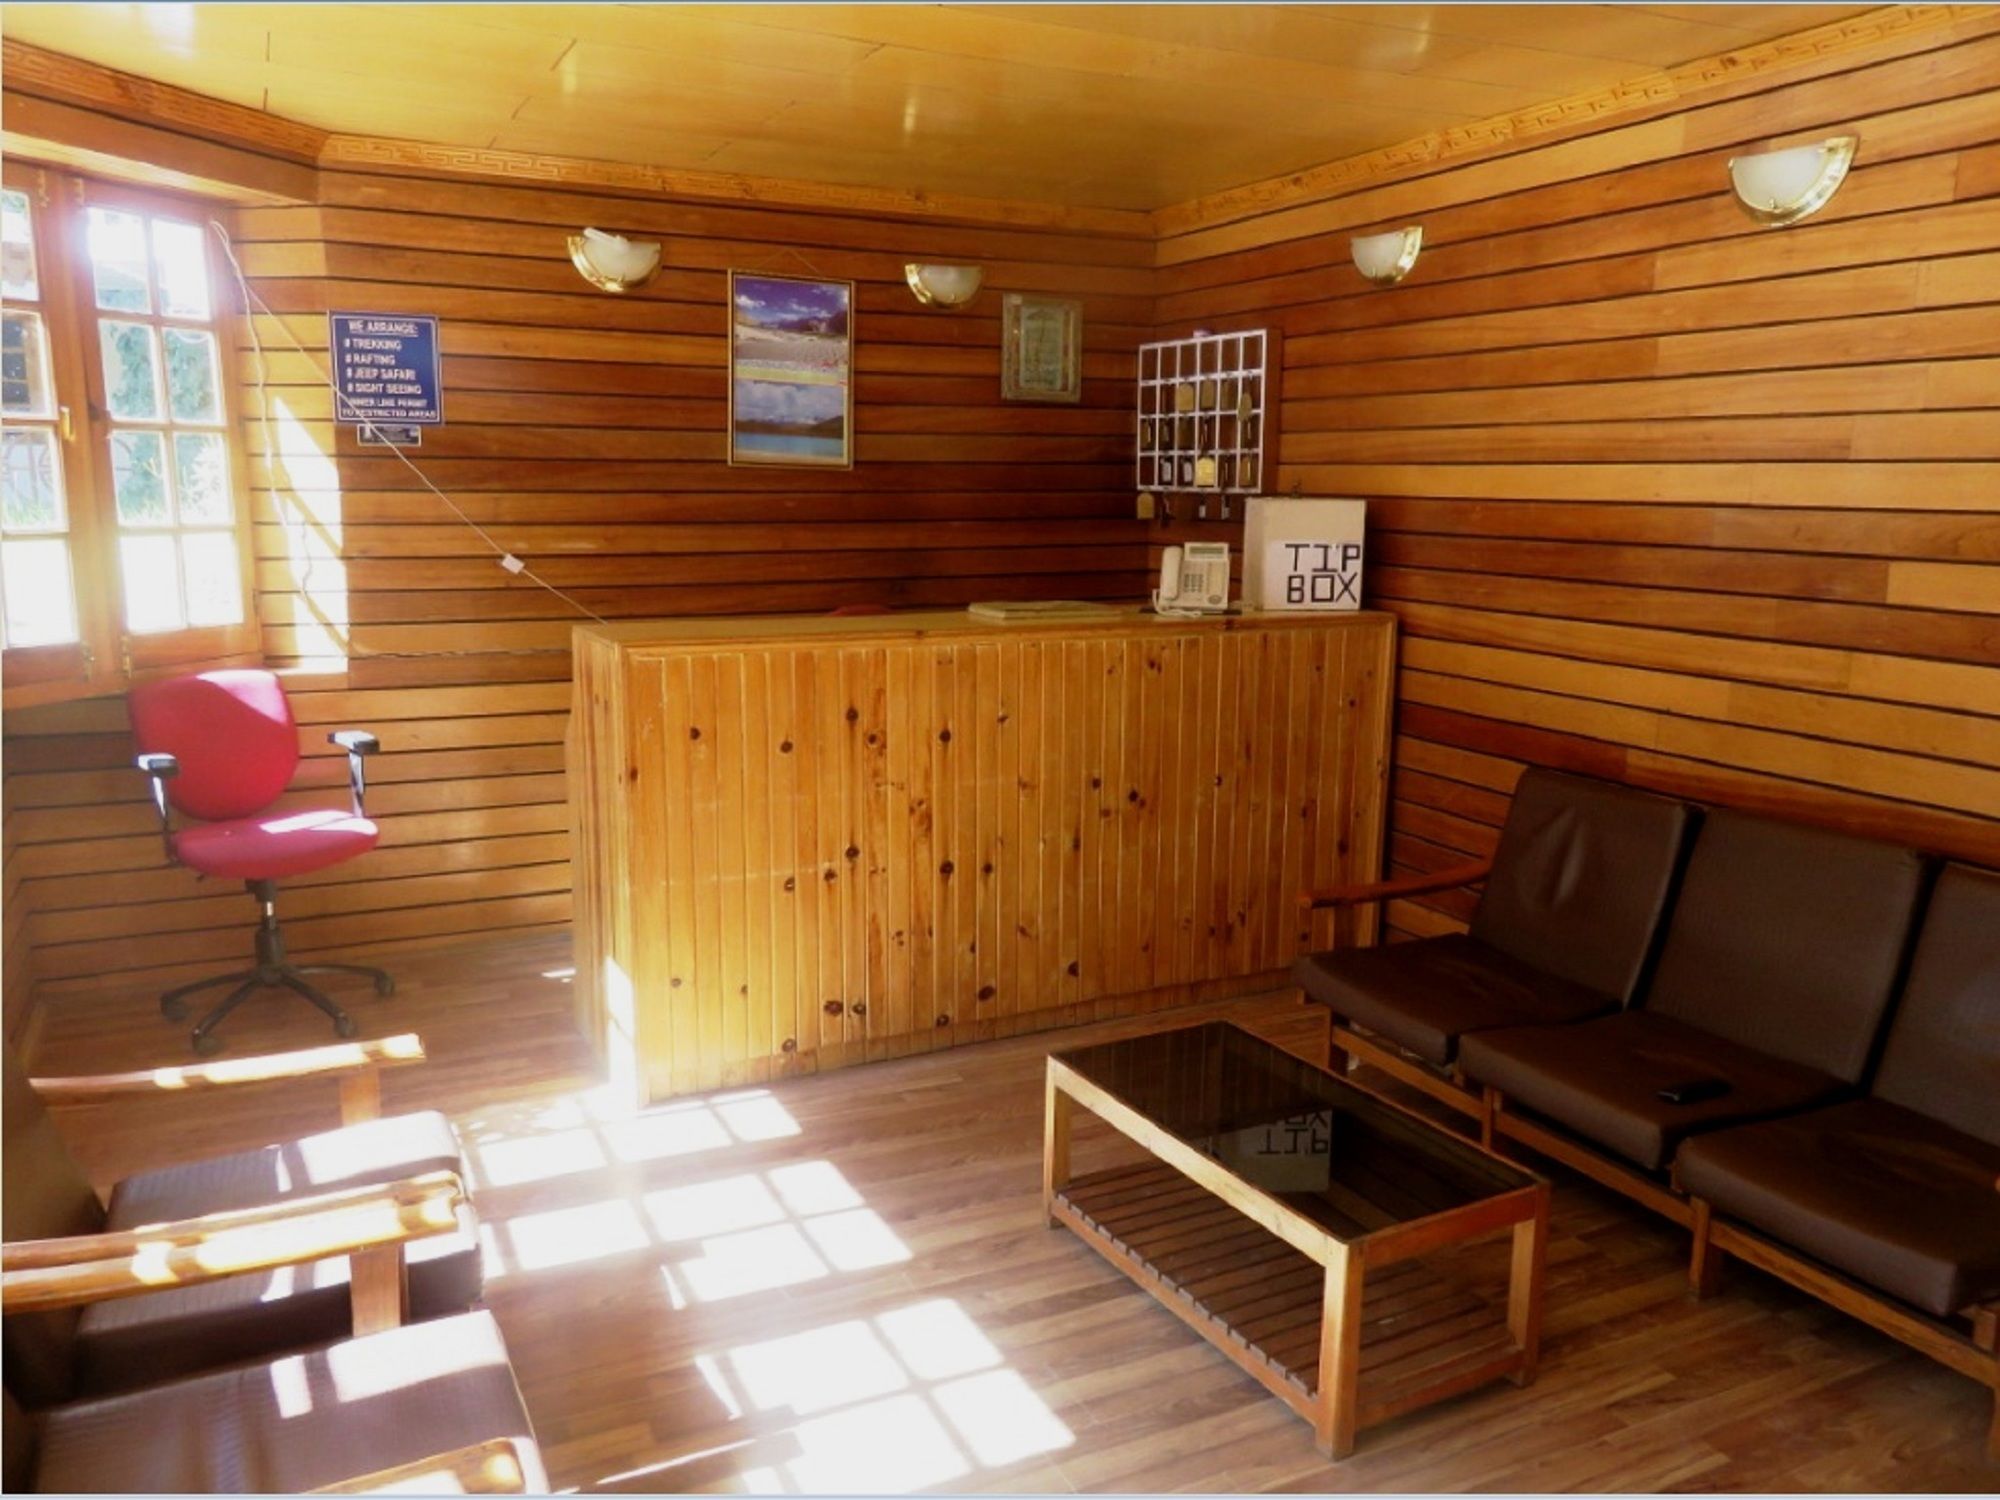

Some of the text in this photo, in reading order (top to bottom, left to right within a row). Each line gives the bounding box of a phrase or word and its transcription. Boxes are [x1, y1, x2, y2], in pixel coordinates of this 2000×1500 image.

[348, 320, 363, 332] WE
[352, 338, 402, 351] TREKKING
[353, 353, 396, 365] RAFTING
[354, 367, 417, 381] JEEP SAFARI
[355, 383, 422, 395] SIGHT SEEING
[1285, 544, 1360, 572] TIP
[1286, 572, 1358, 603] BOX
